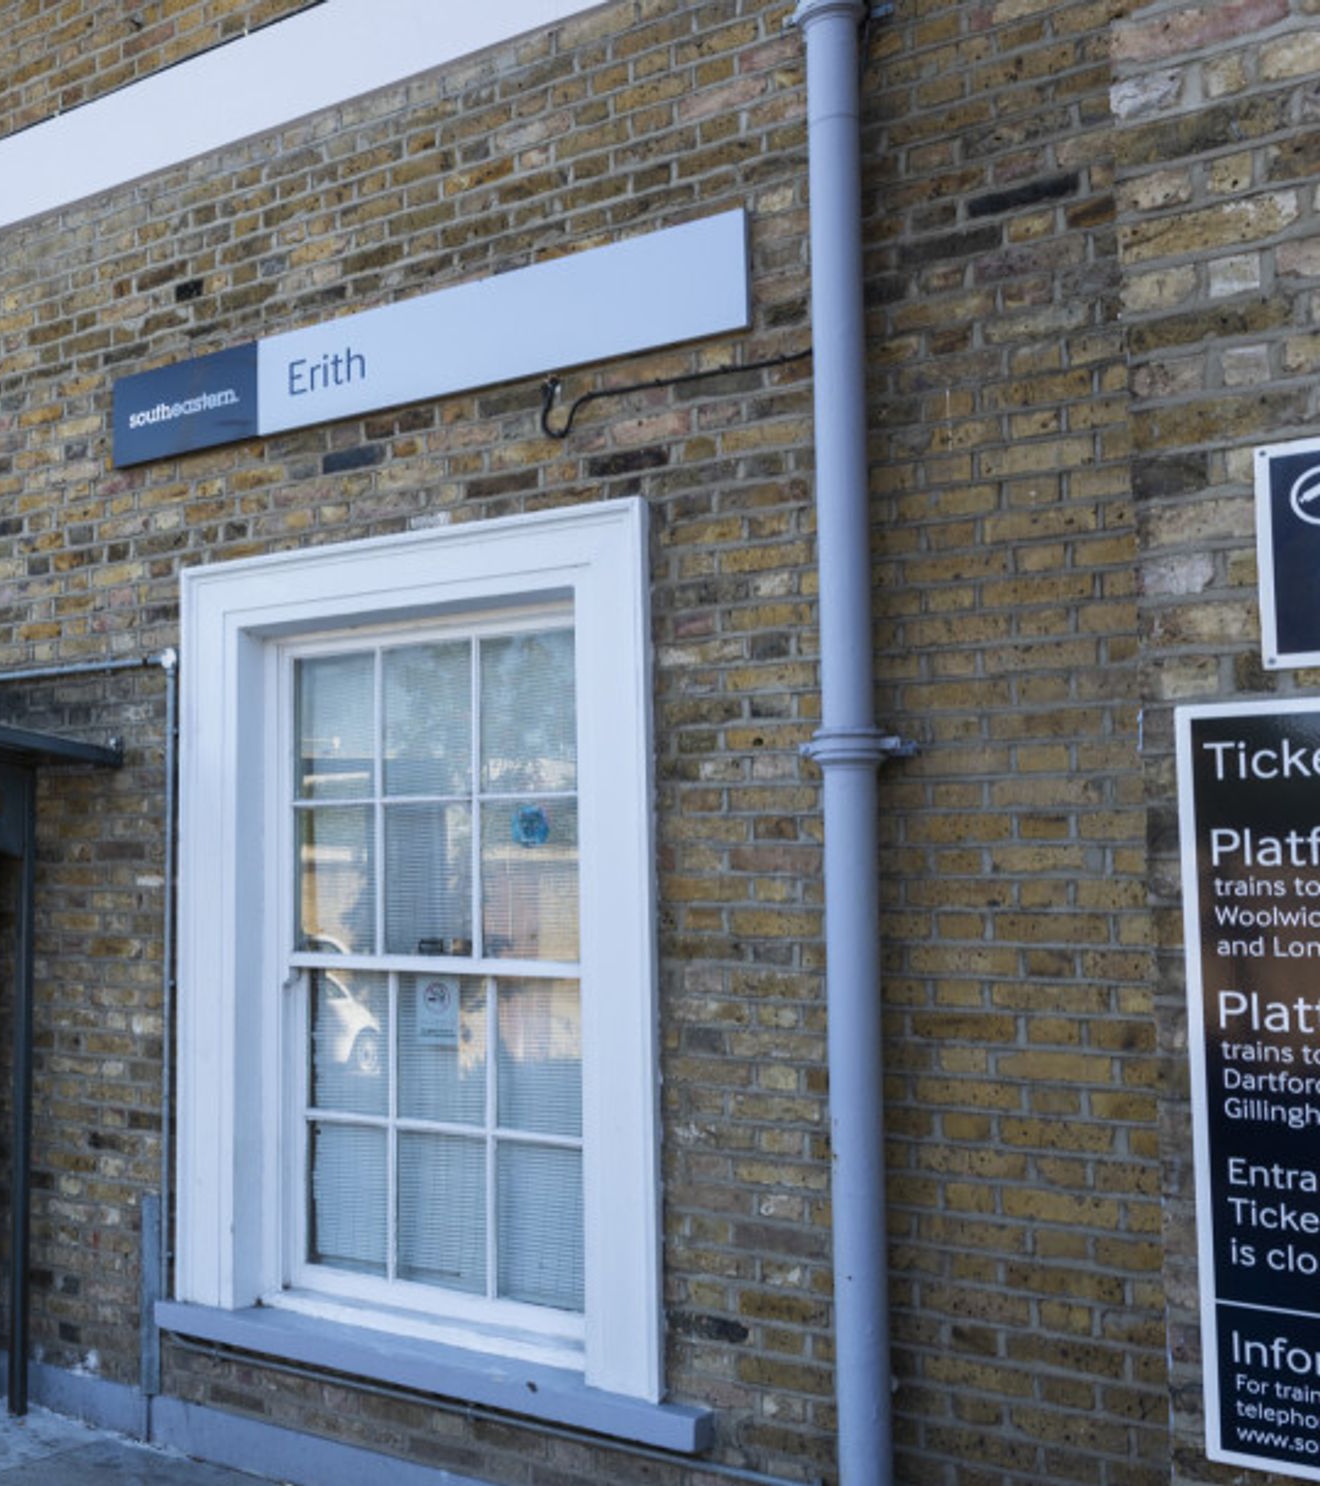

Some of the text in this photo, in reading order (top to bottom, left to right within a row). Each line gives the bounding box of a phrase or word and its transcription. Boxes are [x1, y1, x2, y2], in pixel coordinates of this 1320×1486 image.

[288, 347, 366, 396] Erith
[1202, 737, 1320, 781] Tick
[1209, 826, 1320, 867] Platf
[1213, 875, 1320, 897] trains to
[1215, 905, 1320, 928] Woolwic
[1217, 935, 1320, 958] and Lon
[1218, 989, 1320, 1033] Plat
[1222, 1041, 1295, 1064] trains
[1224, 1096, 1320, 1129] Gillingh
[1228, 1156, 1318, 1192] Entra
[1227, 1196, 1320, 1234] Ticke
[1230, 1236, 1318, 1275] is clo
[1236, 1373, 1320, 1404] For train
[1235, 1399, 1320, 1429] telepho
[1236, 1426, 1320, 1454] www.so
